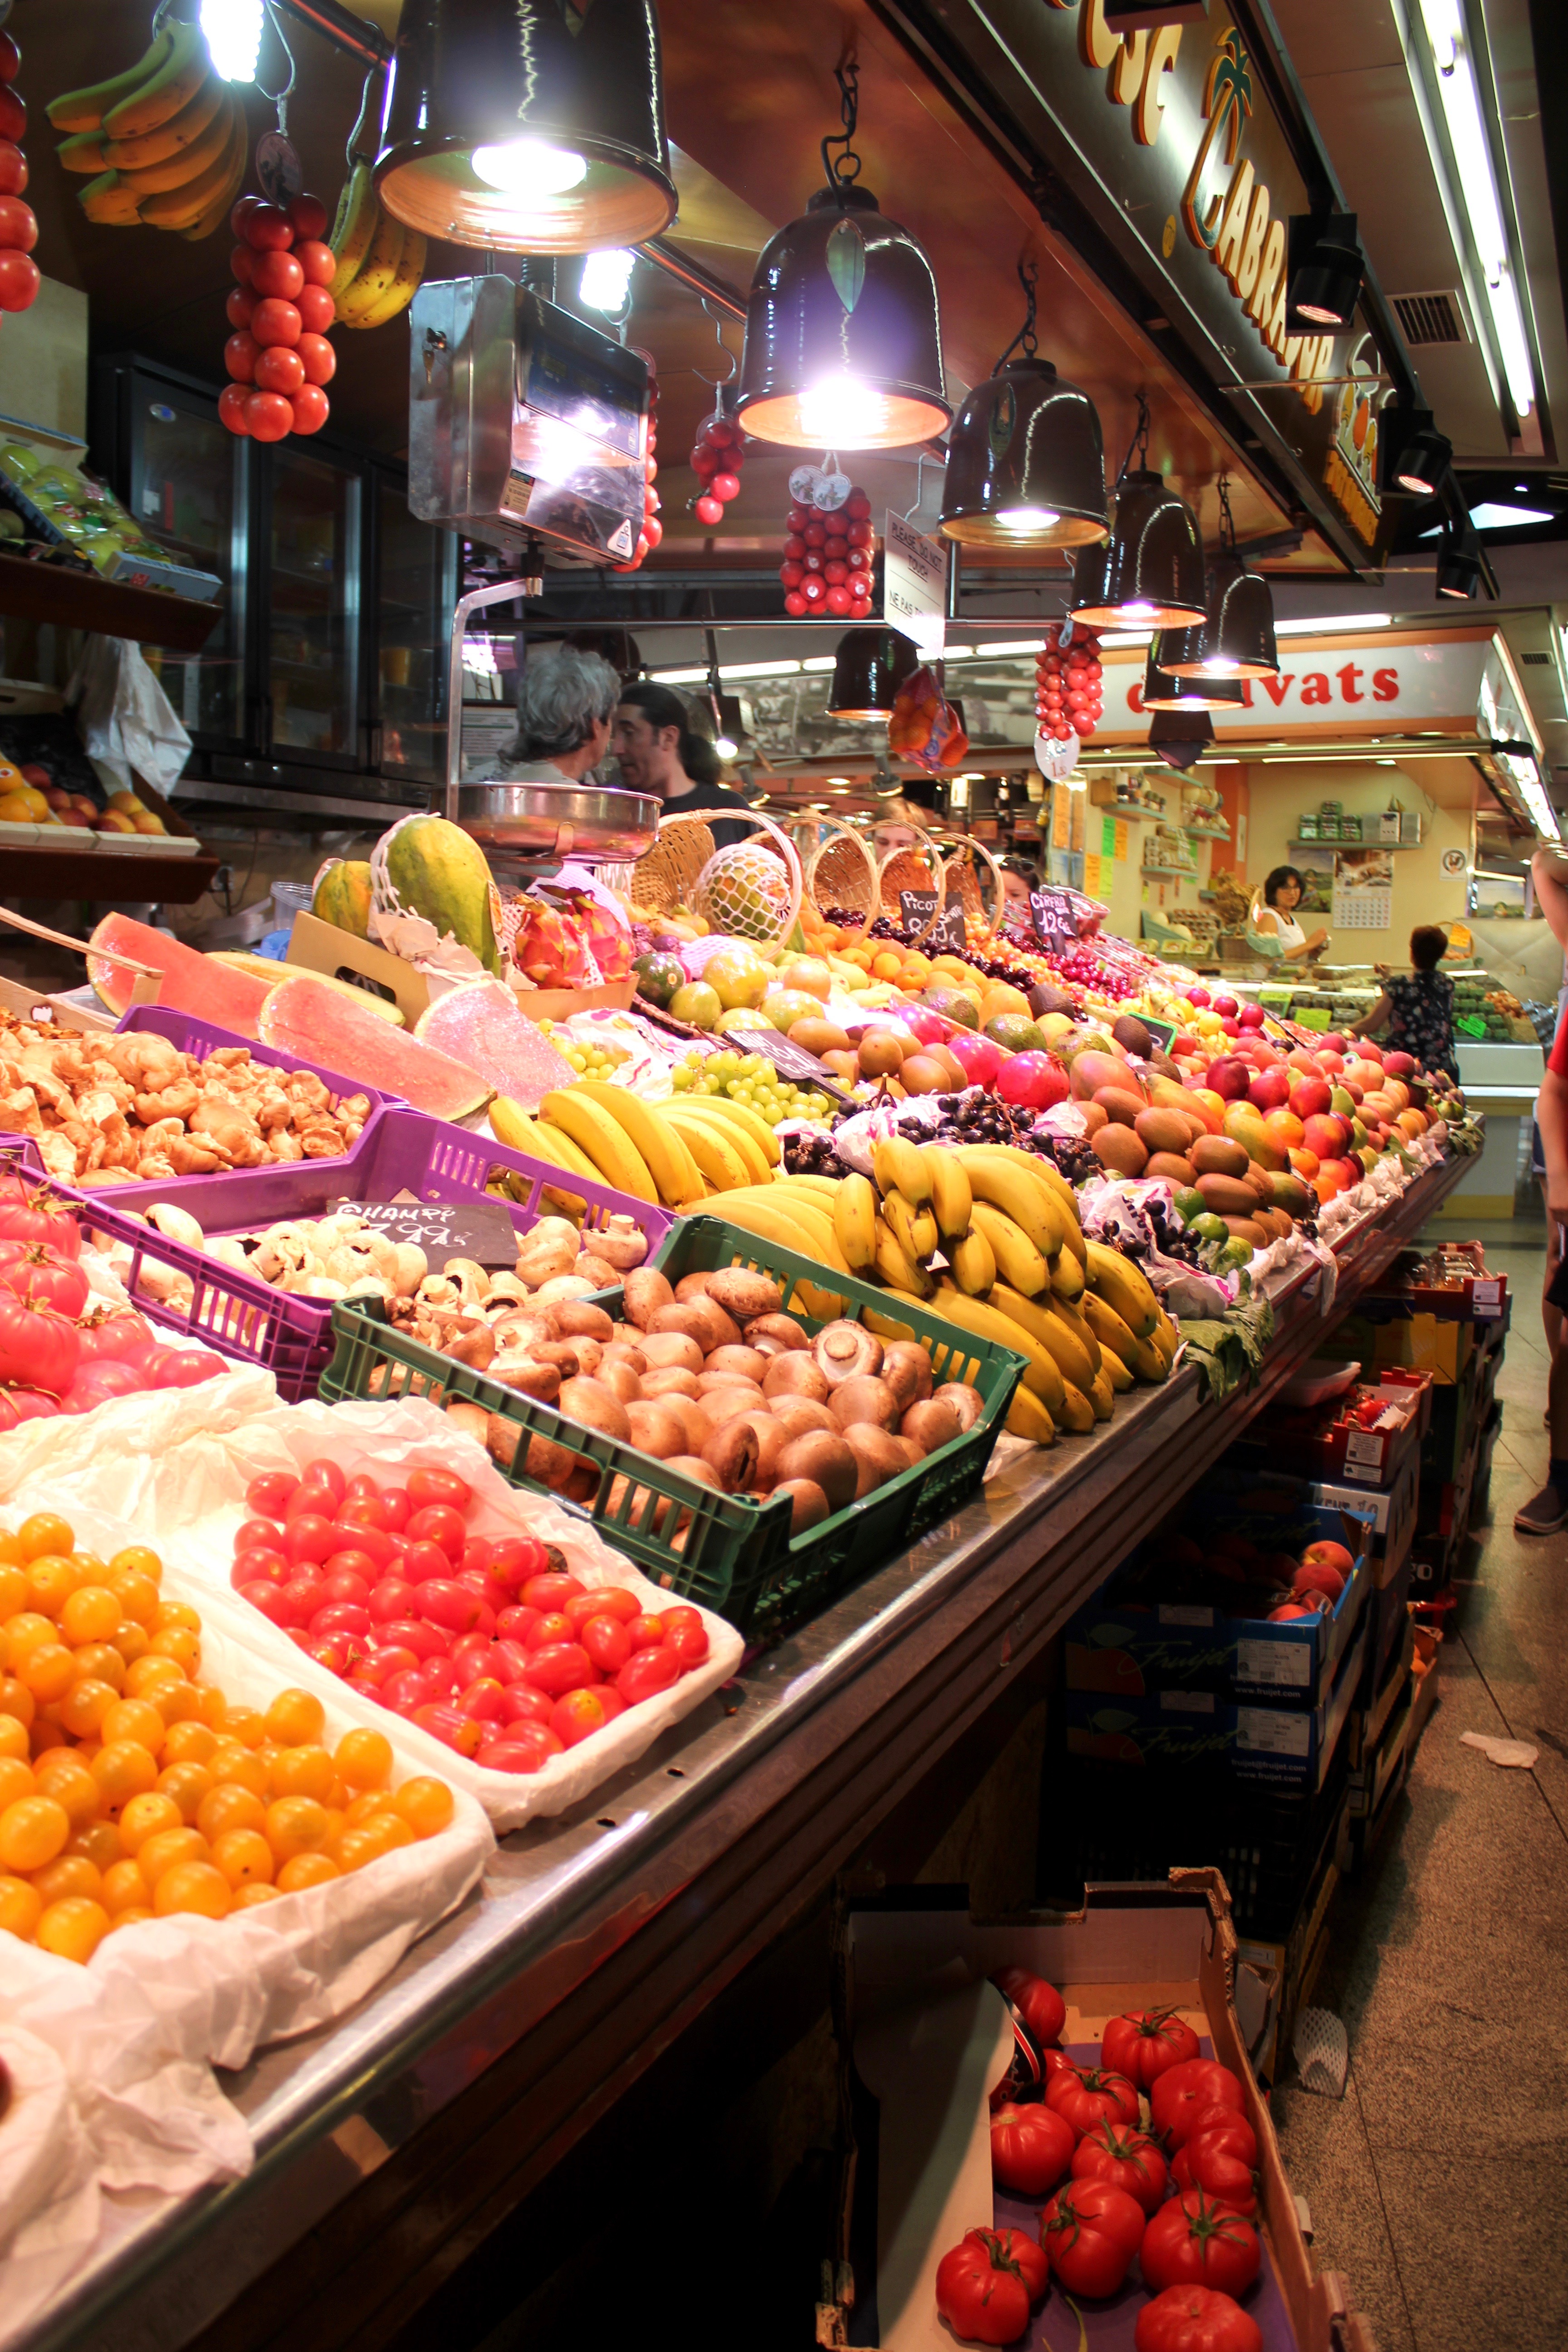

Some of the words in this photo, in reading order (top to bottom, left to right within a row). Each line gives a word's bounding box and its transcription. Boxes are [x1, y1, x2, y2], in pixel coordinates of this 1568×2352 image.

[908, 554, 928, 579] TOUCH
[920, 542, 928, 558] DO
[930, 550, 942, 567] NOT
[889, 589, 899, 607] NE
[901, 597, 913, 614] PAS
[1126, 662, 1399, 714] vats
[1234, 1686, 1301, 1698] www.fruijet.com
[1231, 1758, 1307, 1772] fruijet@fruijet.com
[1235, 1770, 1302, 1783] www.fruijet.com
